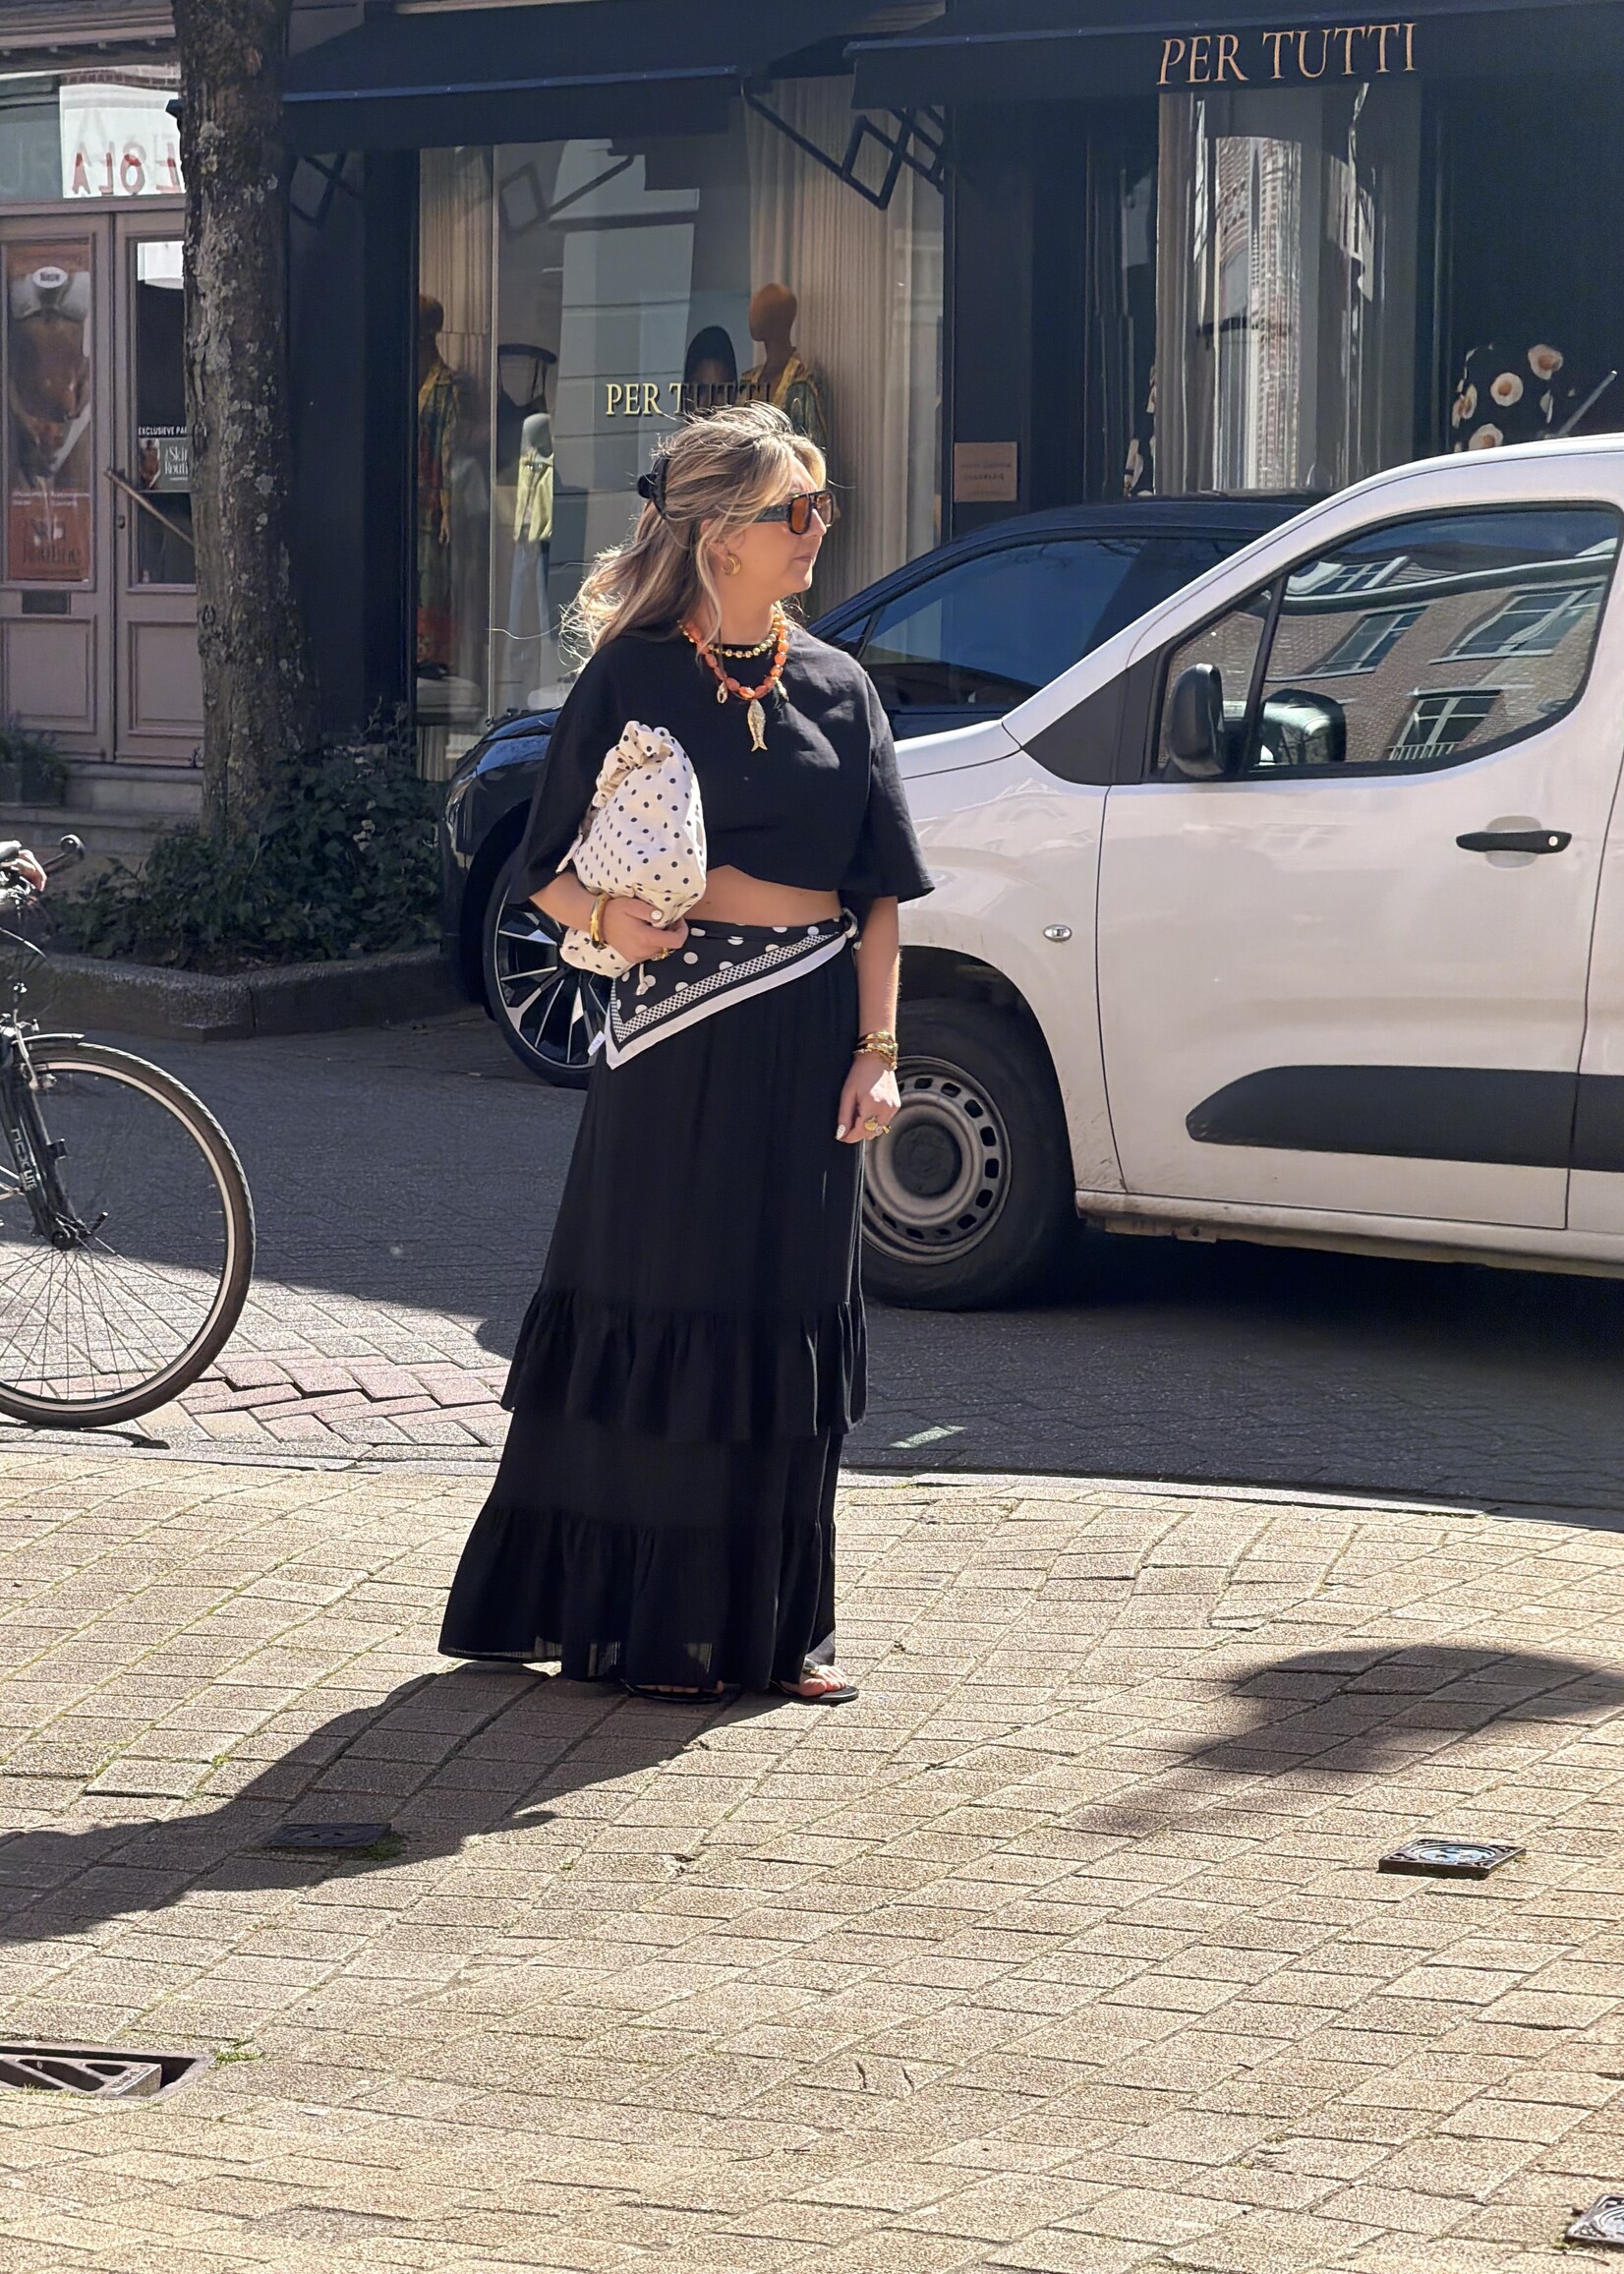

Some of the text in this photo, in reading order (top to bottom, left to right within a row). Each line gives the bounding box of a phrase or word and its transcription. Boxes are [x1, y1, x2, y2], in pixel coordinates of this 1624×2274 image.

[1156, 23, 1418, 86] PER TUTTI
[606, 382, 664, 415] PER
[138, 426, 175, 436] EXCLUSIEVE
[24, 1169, 37, 1191] LITE
